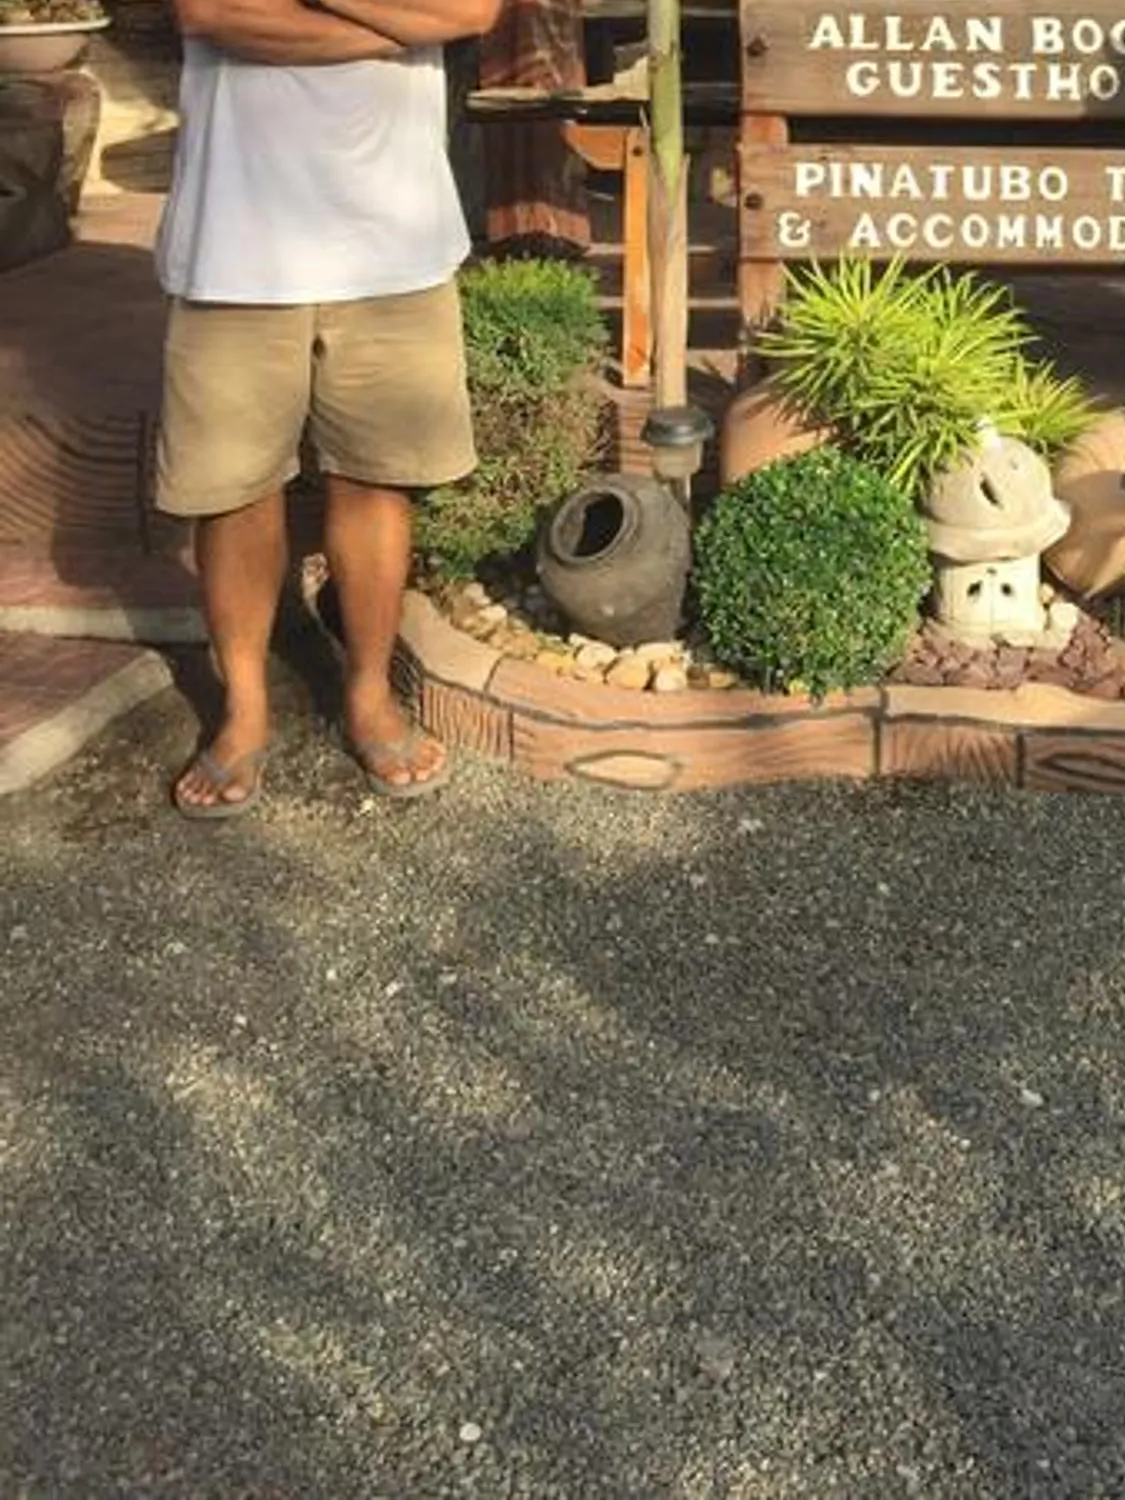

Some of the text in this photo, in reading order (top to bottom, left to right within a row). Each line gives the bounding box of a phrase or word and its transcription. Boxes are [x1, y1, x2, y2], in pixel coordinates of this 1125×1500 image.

[808, 14, 1002, 51] ALLAN
[794, 162, 1070, 199] PINATUBO
[776, 211, 813, 250] &
